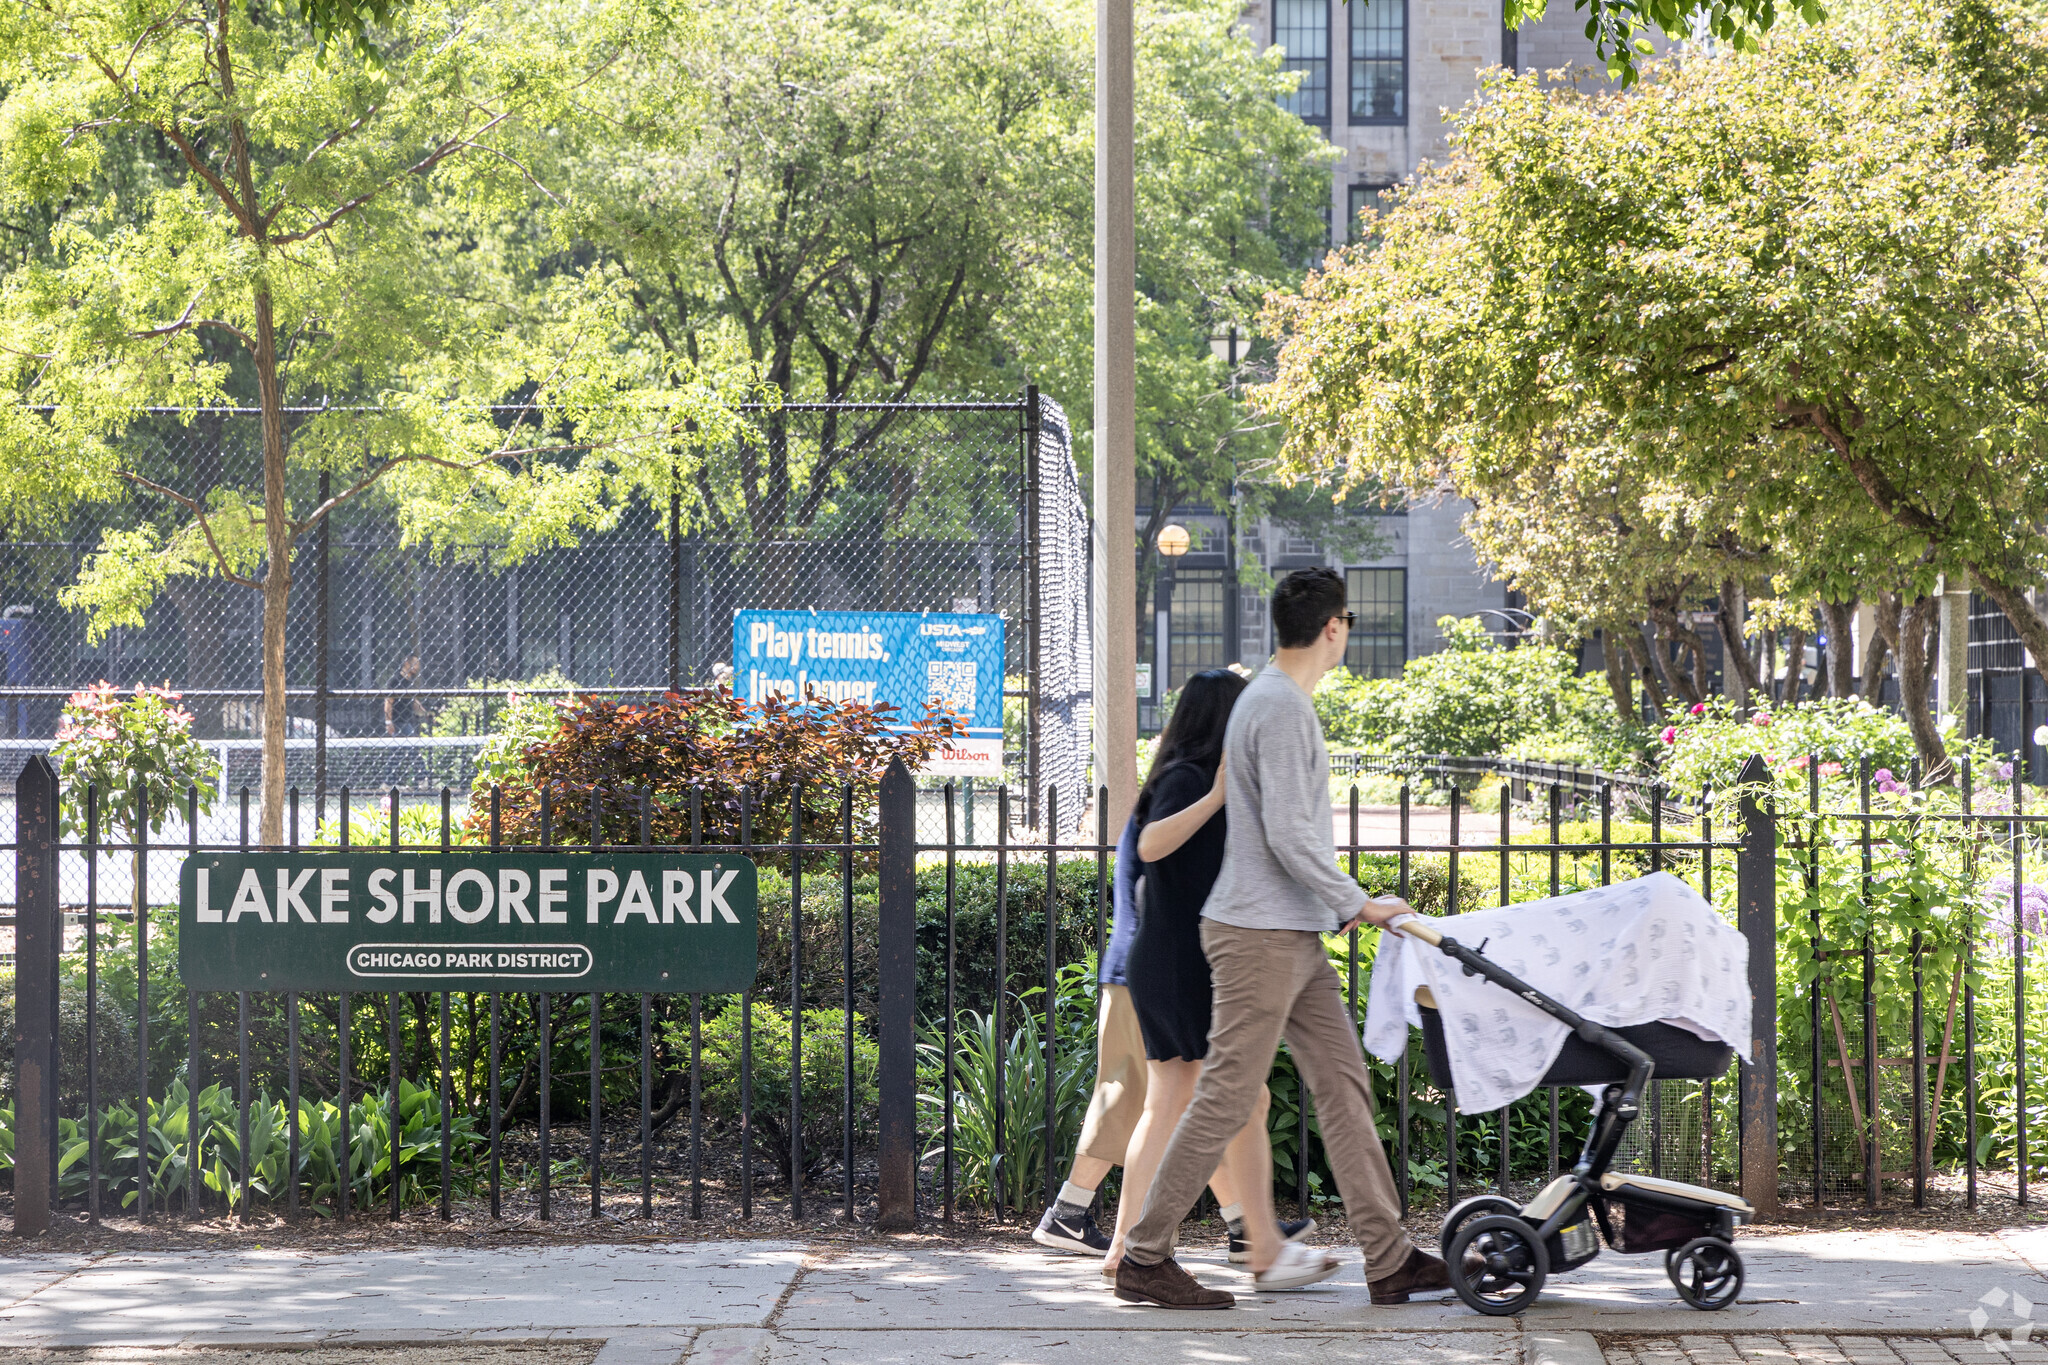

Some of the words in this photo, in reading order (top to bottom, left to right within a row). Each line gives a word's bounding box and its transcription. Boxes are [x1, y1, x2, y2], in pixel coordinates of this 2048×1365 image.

[920, 623, 963, 637] USTA
[750, 621, 803, 665] Play
[806, 625, 890, 663] tennis,
[936, 640, 970, 648] MIDWEST
[750, 669, 796, 706] live
[941, 748, 990, 761] Wilson
[197, 868, 349, 923] LAKE
[365, 868, 568, 924] SHORE
[587, 869, 740, 924] PARK
[357, 952, 442, 969] CHICAGO
[445, 953, 494, 968] PARK
[497, 953, 582, 968] DISTRICT
